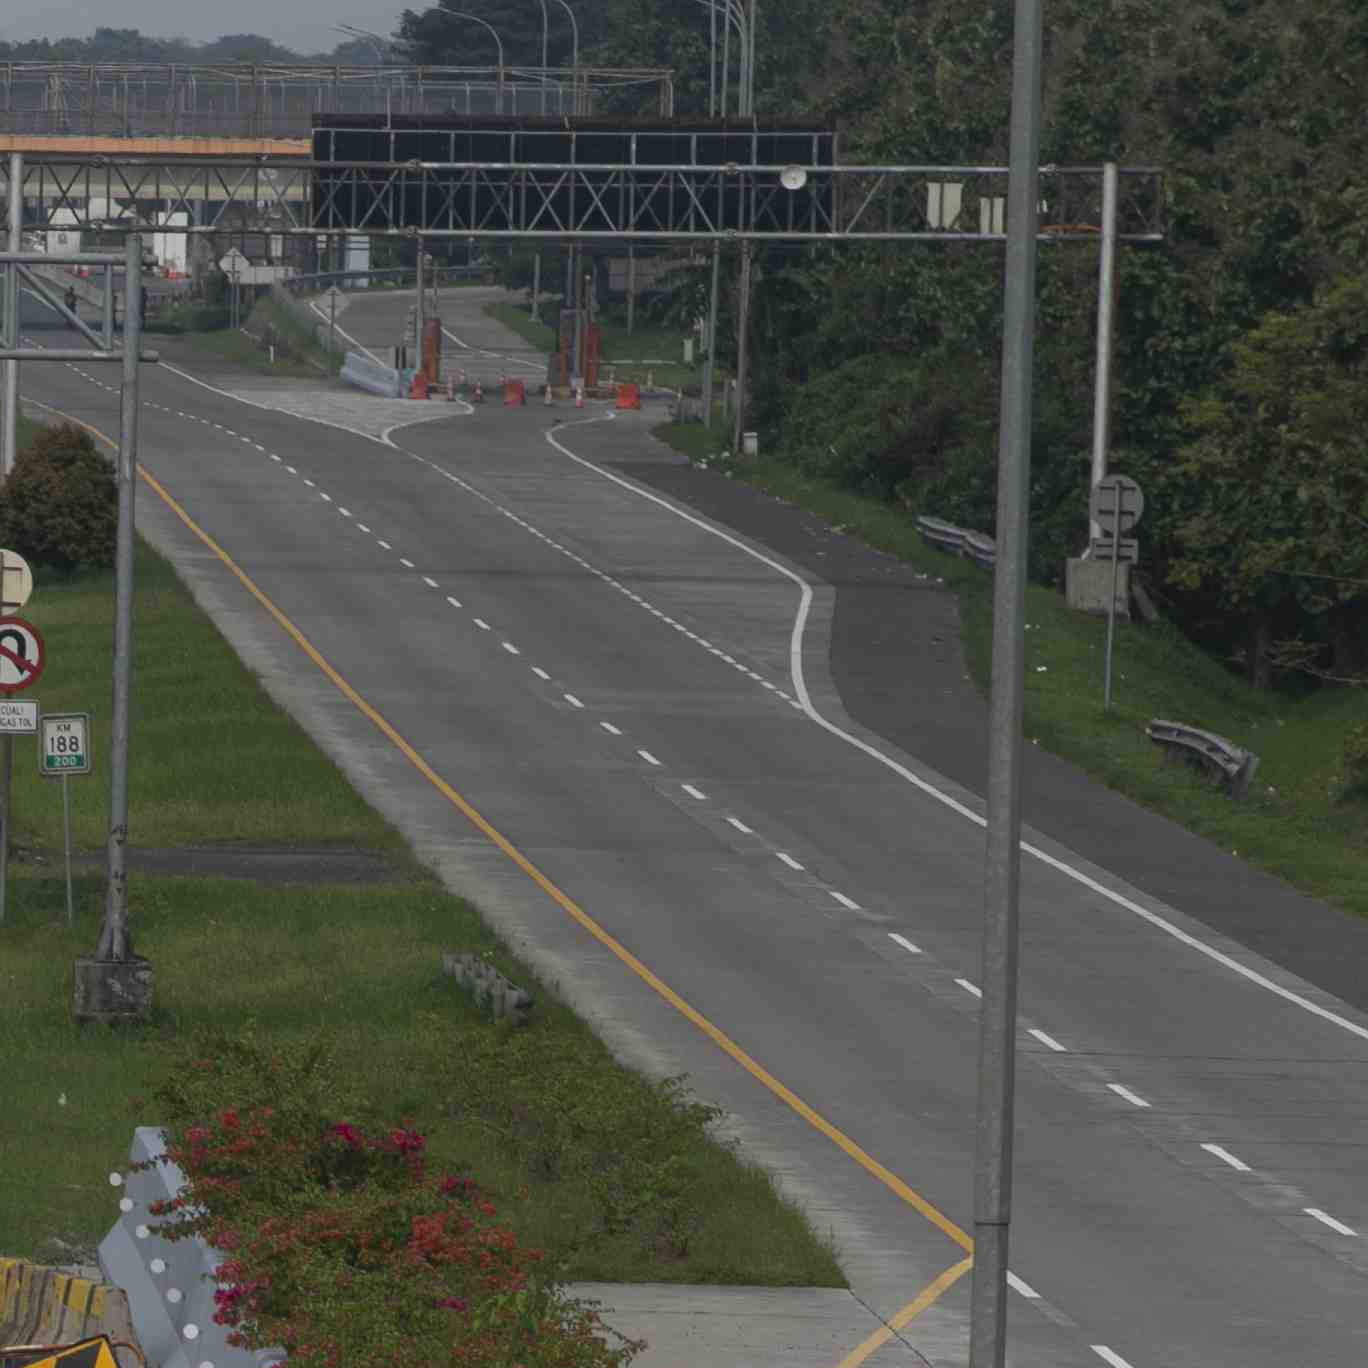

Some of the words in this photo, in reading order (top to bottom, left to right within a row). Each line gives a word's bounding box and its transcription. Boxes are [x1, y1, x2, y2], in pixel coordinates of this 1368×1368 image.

[57, 724, 72, 732] KM
[49, 736, 80, 753] 188
[53, 757, 78, 766] 200
